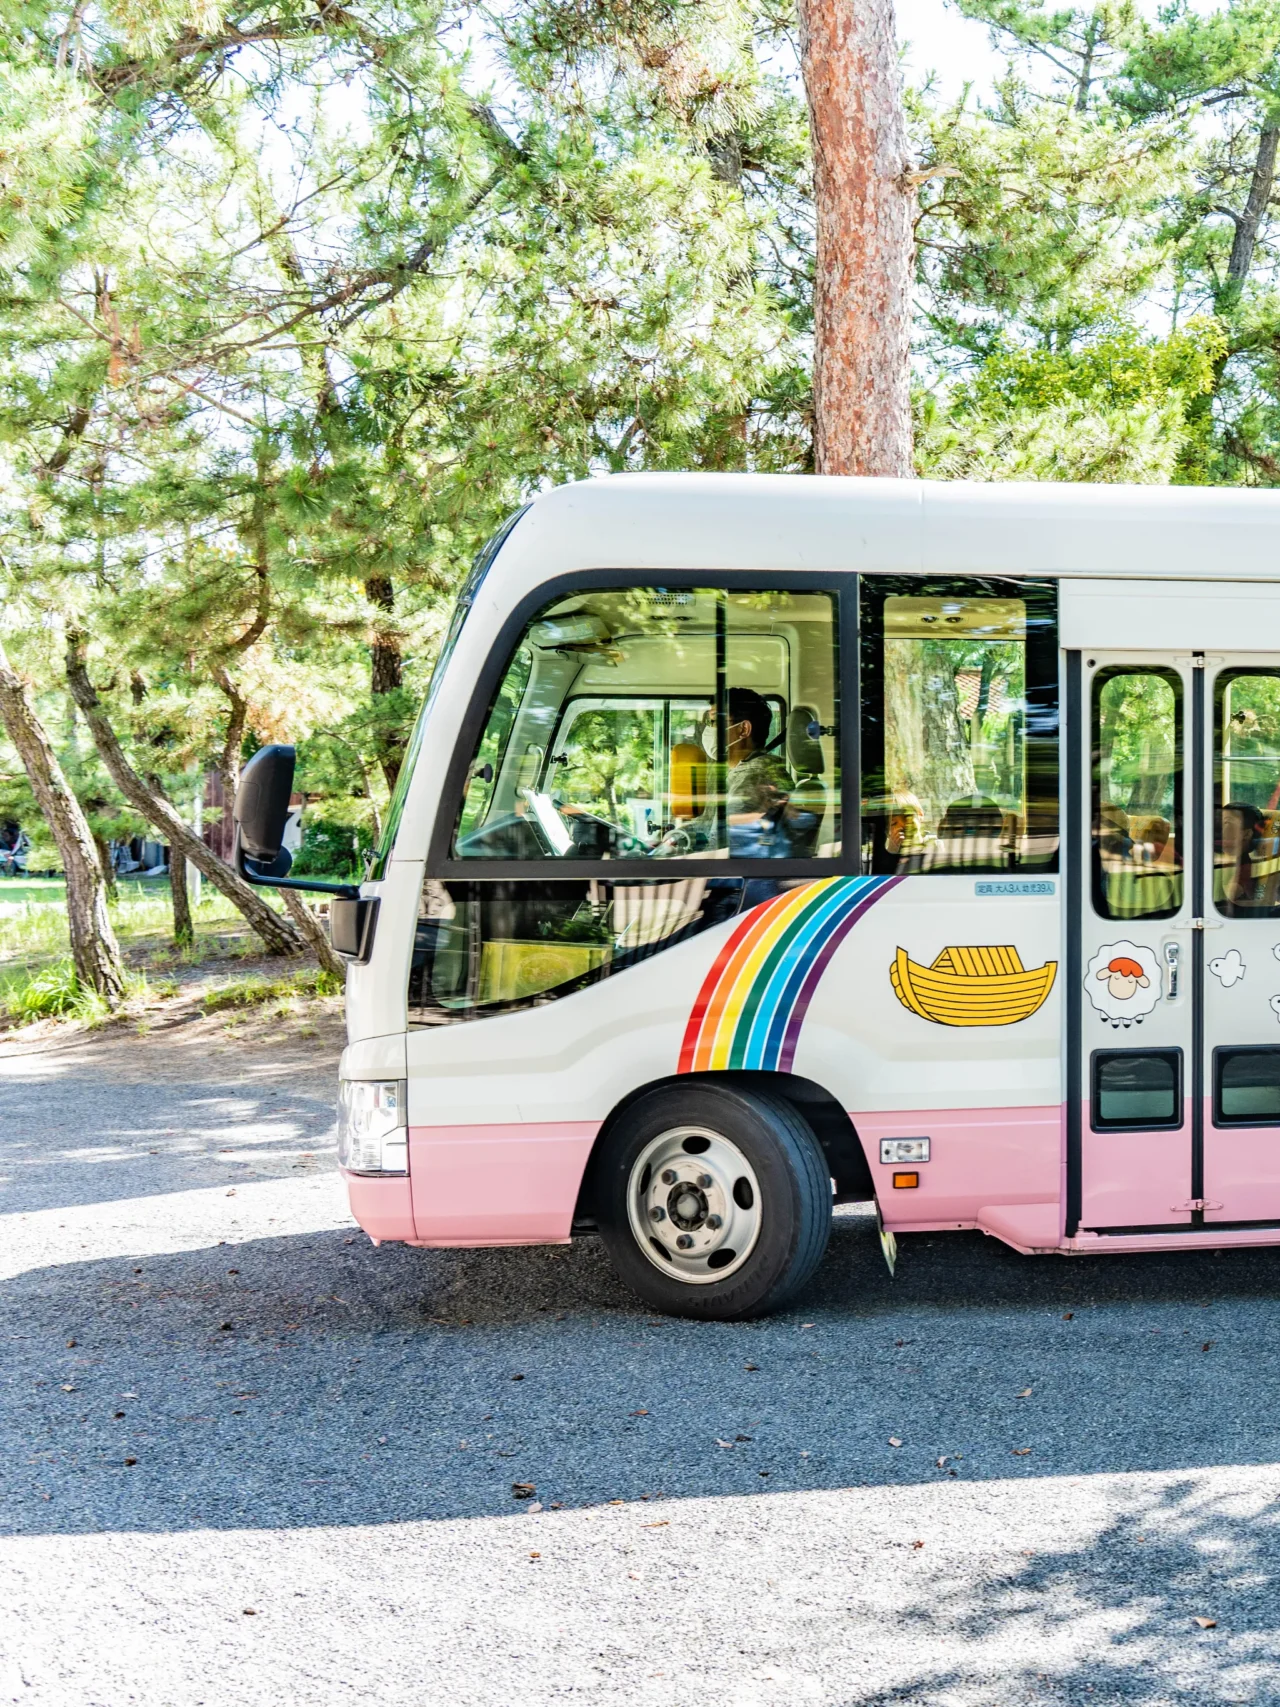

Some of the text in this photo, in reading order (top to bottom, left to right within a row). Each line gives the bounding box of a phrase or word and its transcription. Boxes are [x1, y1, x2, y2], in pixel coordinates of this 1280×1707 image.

[978, 884, 993, 894] 定員
[996, 883, 1021, 893] 大人3人
